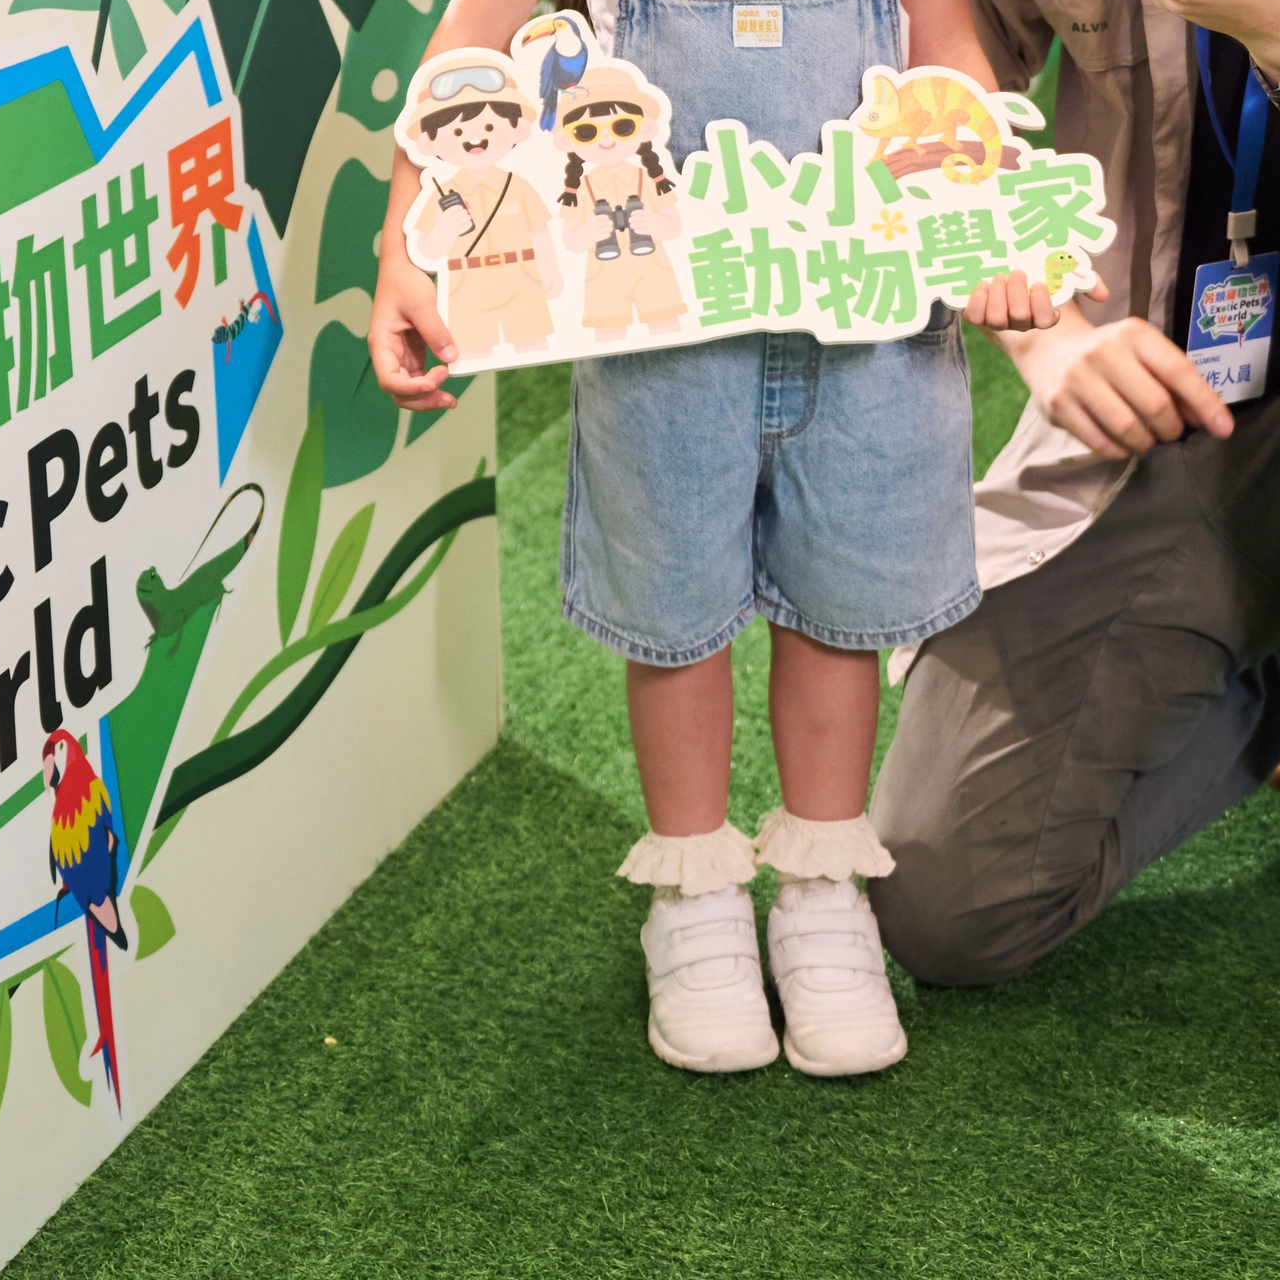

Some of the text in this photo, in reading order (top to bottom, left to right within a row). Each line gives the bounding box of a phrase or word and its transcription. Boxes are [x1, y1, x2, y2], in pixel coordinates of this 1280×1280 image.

[736, 19, 779, 32] WHEEL
[687, 128, 903, 227] 小小
[687, 159, 1106, 331] 動物學家
[1204, 282, 1268, 304] 另類寵物世界
[1209, 297, 1260, 315] Exotic Pets
[1217, 310, 1248, 324] World
[1193, 355, 1221, 365] ASMINE
[1201, 363, 1251, 388] 作人員
[27, 367, 201, 573] Pets
